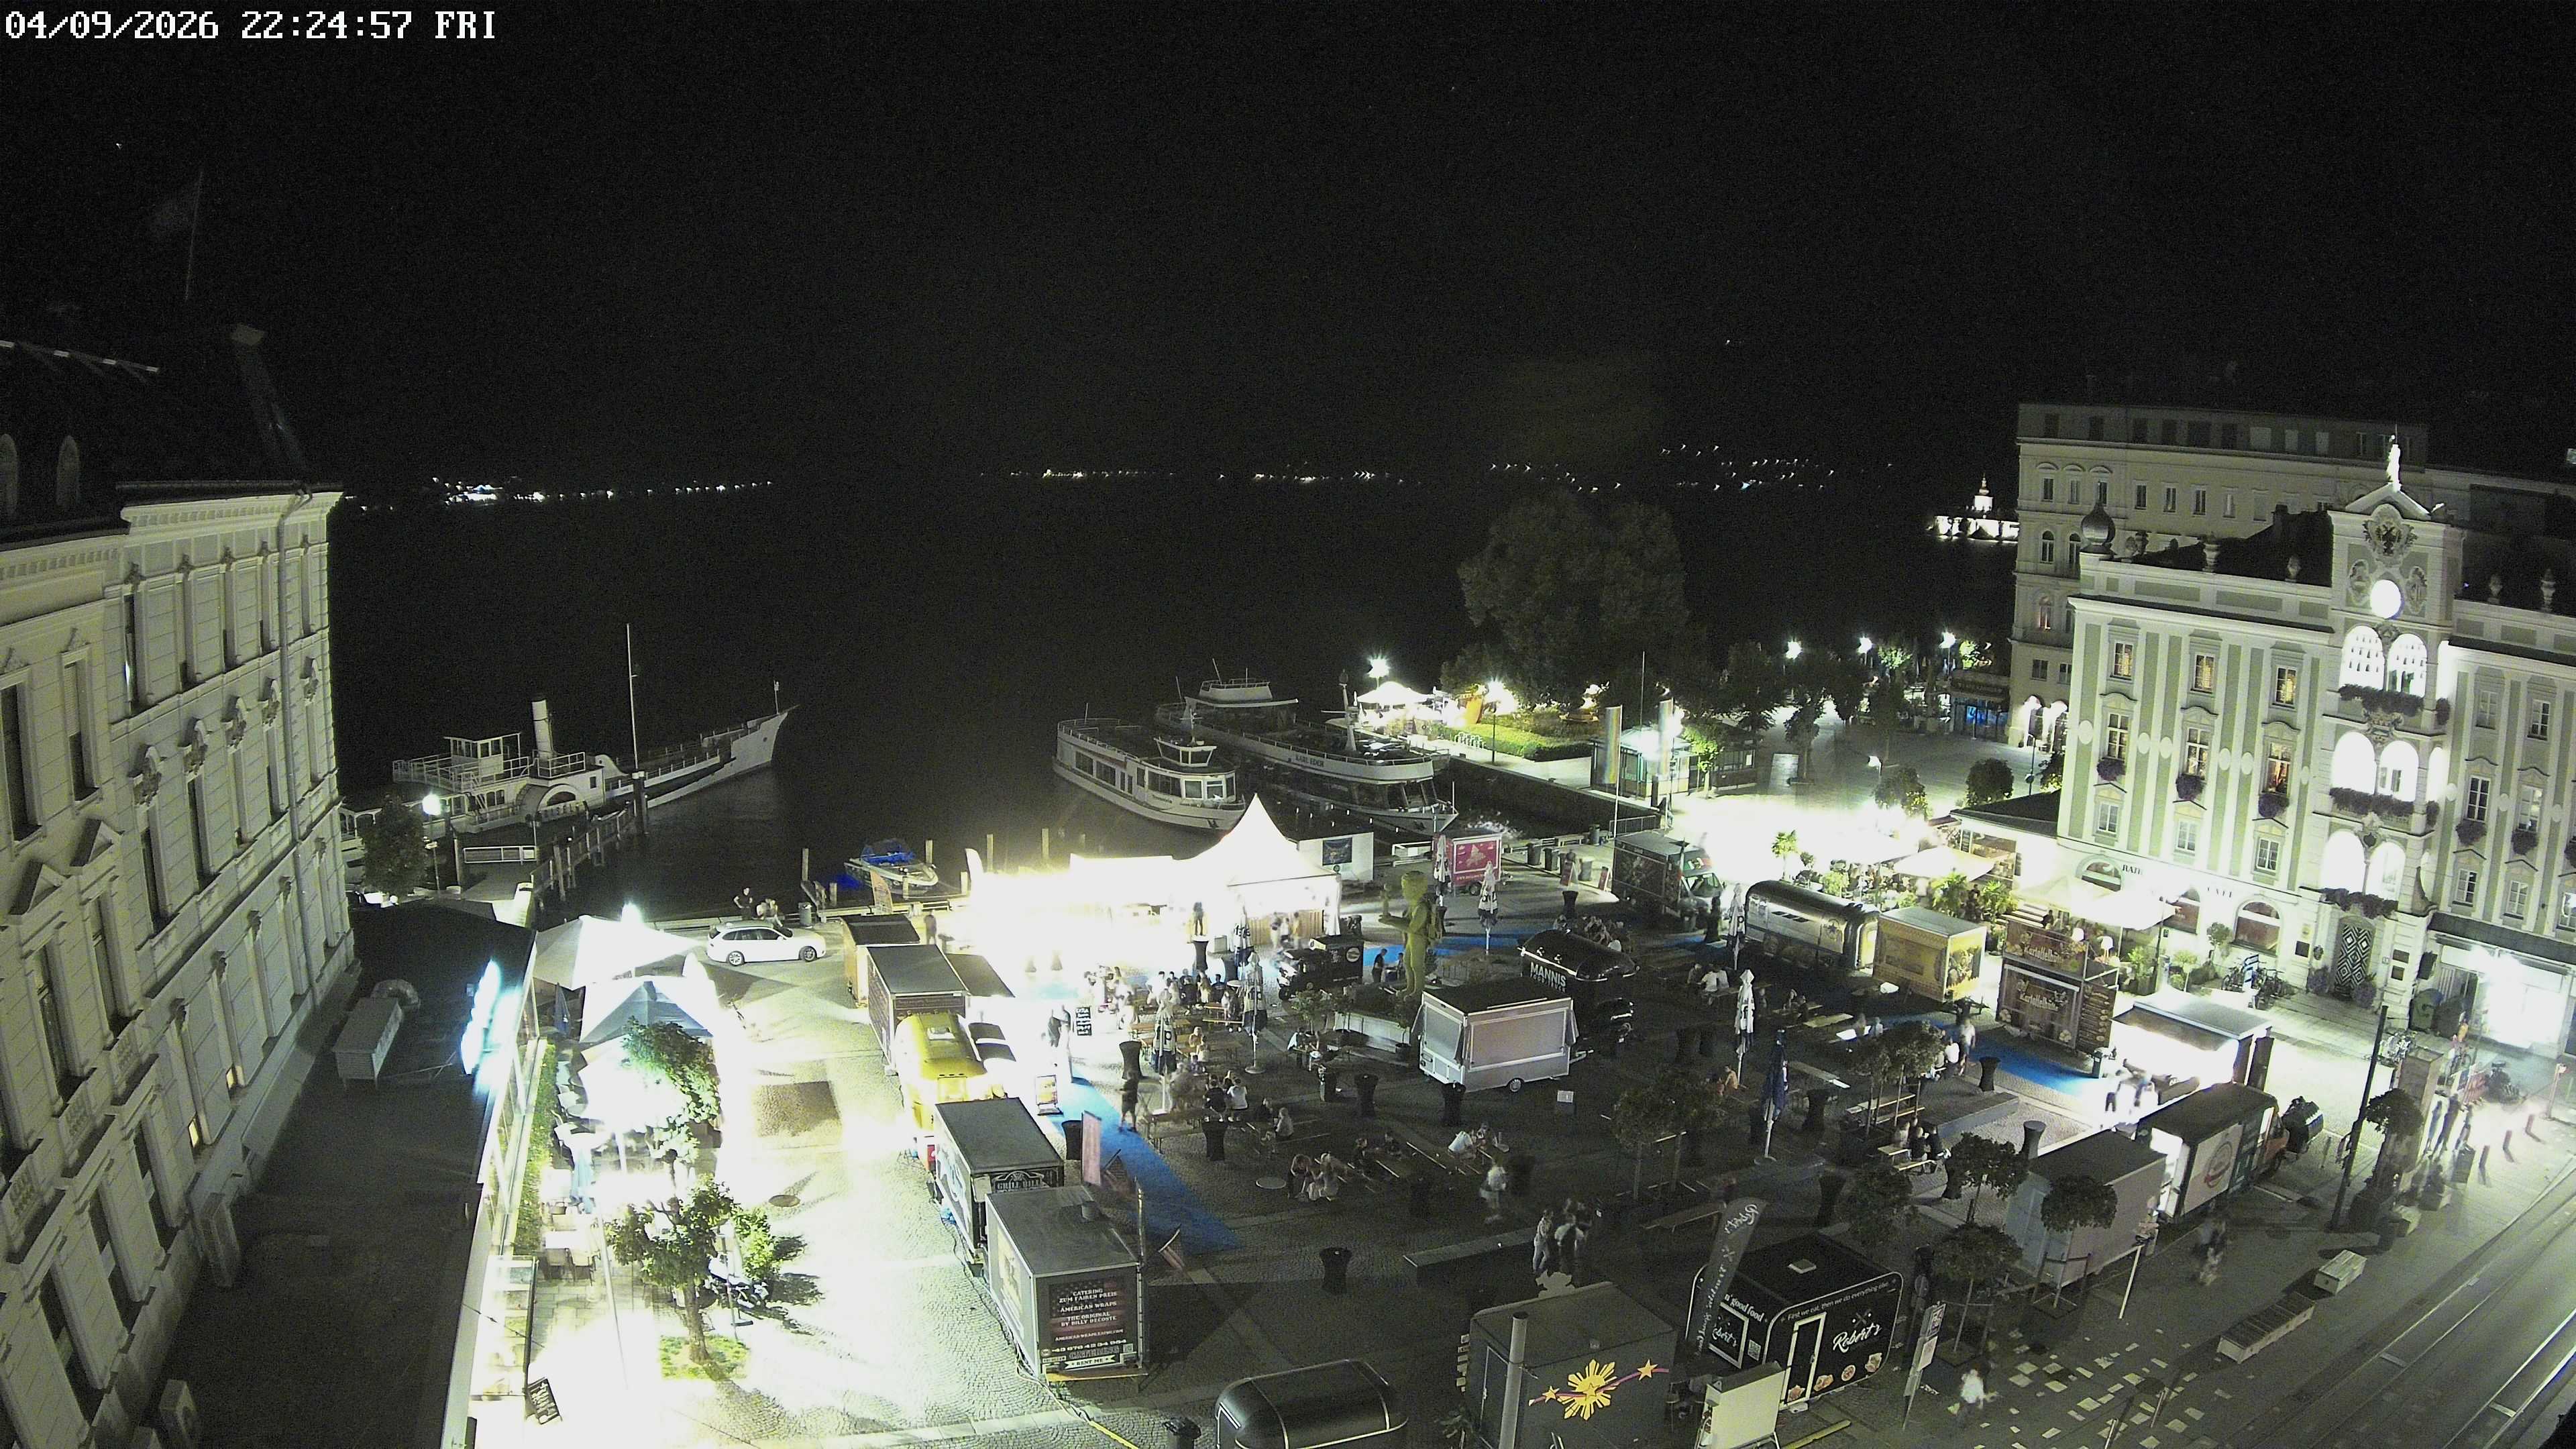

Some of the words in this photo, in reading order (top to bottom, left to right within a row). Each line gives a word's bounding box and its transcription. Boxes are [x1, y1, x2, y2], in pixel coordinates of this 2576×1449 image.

[1530, 961, 1566, 987] MANNIS
[1073, 1288, 1104, 1296] CATERING
[1060, 1304, 1093, 1313] AMERICAN
[1731, 1297, 1748, 1313] good
[1747, 1305, 1764, 1322] food
[1833, 1323, 1882, 1353] Robert's
